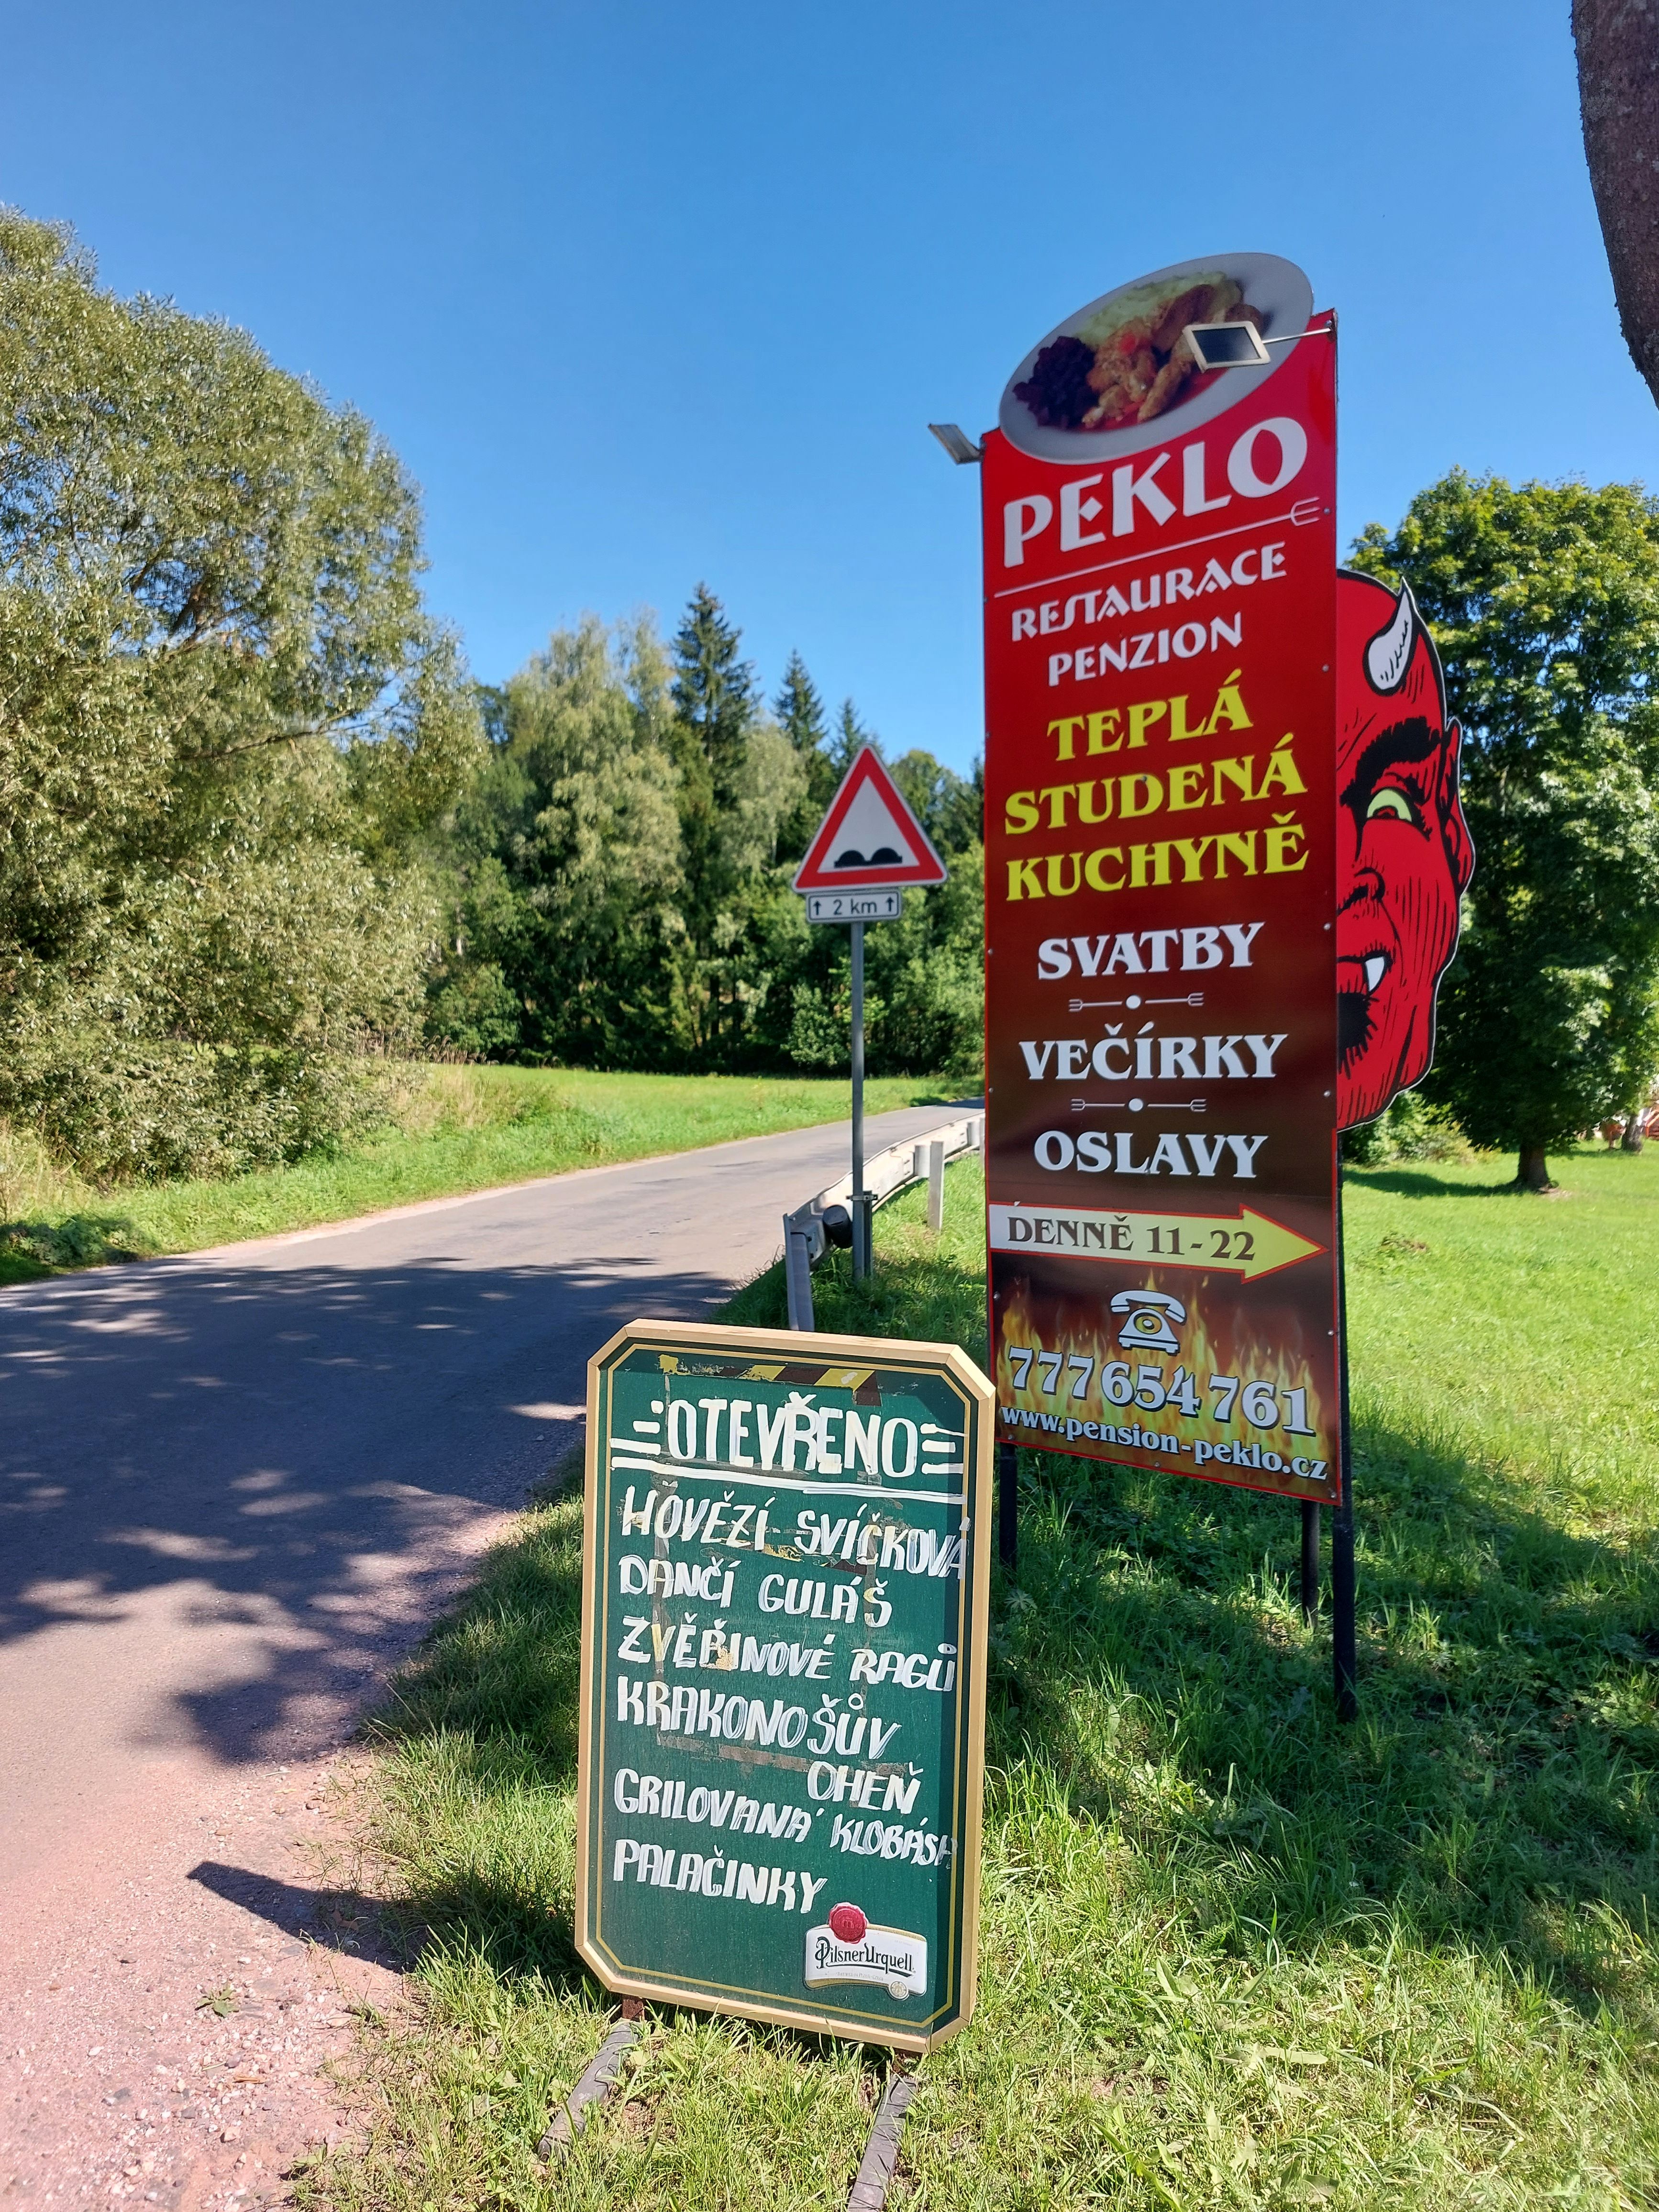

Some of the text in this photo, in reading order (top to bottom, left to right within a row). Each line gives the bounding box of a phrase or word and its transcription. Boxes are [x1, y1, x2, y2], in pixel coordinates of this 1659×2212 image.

[1004, 417, 1307, 568] PEKLO
[1011, 542, 1286, 641] RESTAURACE
[1048, 611, 1242, 686] PENZION
[1047, 668, 1254, 761] TEPLÁ
[1005, 732, 1308, 834] STUDENÁ
[1006, 810, 1309, 901] KUCHYNĚ
[833, 898, 877, 915] 2 km
[1038, 922, 1266, 980] SVATBY
[1019, 1021, 1288, 1080] VEČÍRKY
[1034, 1130, 1269, 1178] OSLAVY
[1007, 1215, 1134, 1250] DENNĚ
[668, 1392, 918, 1477] OTEVŘENO
[1001, 1406, 1327, 1481] www.pension-peklo.cz
[621, 1485, 971, 1579] HOVĚZÍ SVÍČKOVÁ
[619, 1555, 893, 1627] DANČÍ GULÁŠ
[849, 1643, 957, 1692] RAGŮ
[617, 1675, 903, 1759] KRAKONOŠŮV
[614, 1768, 825, 1843] GRILOVANÁ
[807, 1761, 924, 1814] OHEŇ
[613, 1839, 828, 1914] PALAČINKY
